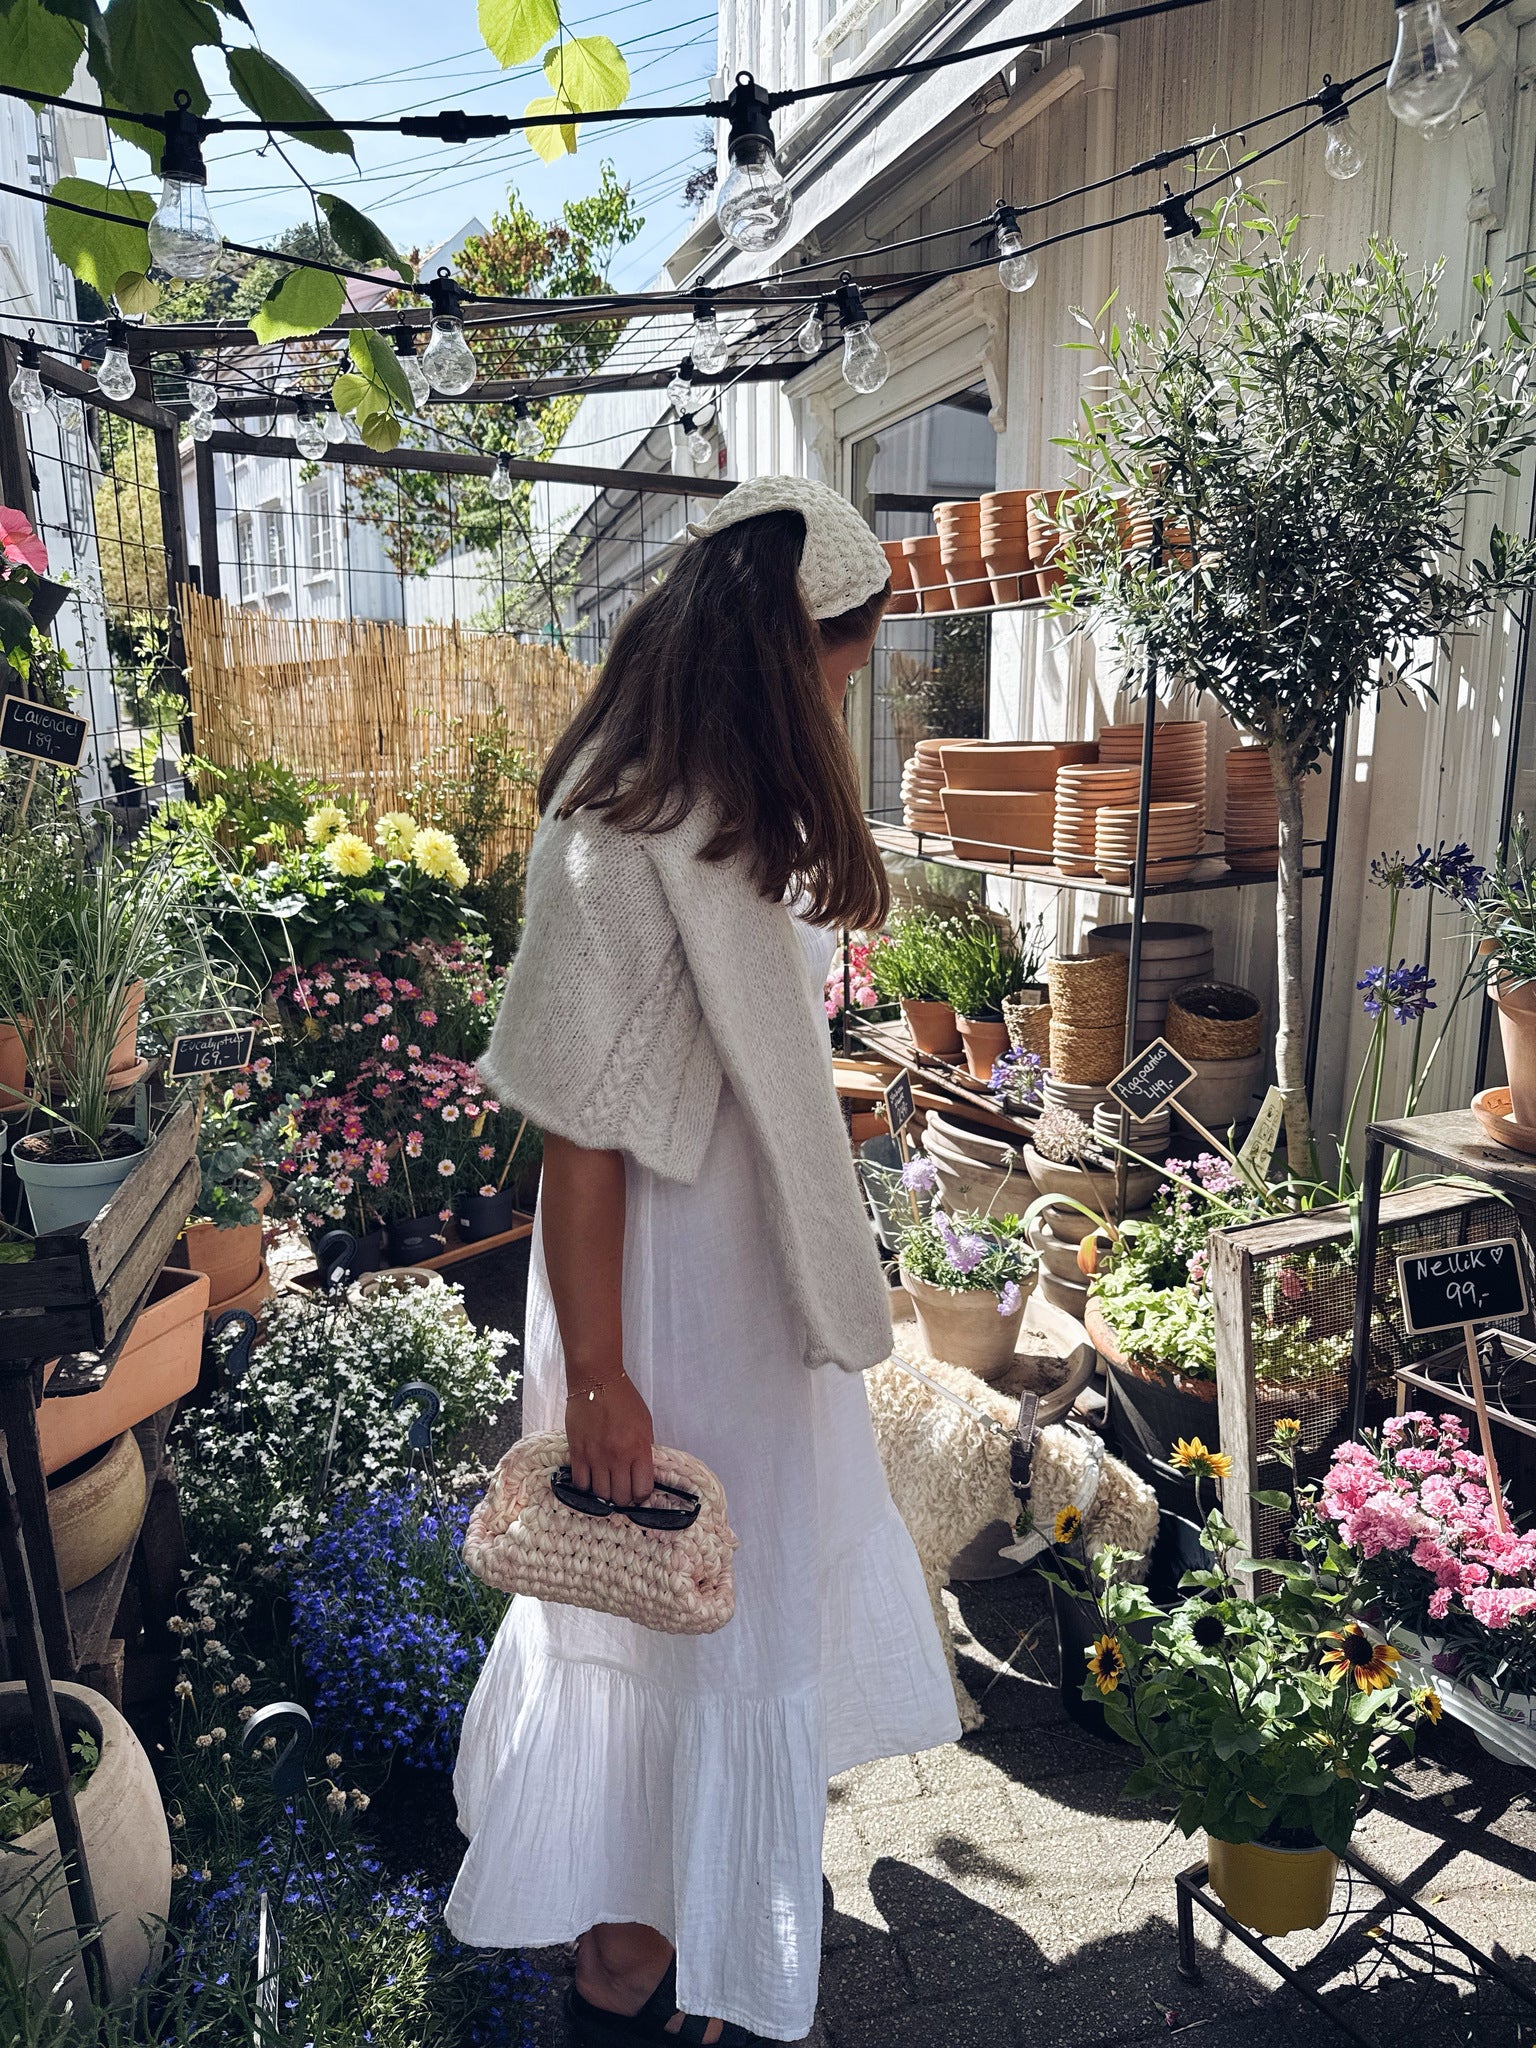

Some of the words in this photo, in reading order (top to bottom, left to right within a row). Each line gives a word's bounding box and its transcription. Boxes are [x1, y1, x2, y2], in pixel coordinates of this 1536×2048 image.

[14, 705, 78, 736] Lavendel
[28, 730, 61, 754] 189,-
[180, 1035, 244, 1052] Eucalyptus
[194, 1051, 230, 1066] 169,-
[1143, 1079, 1174, 1099] 449,-
[1446, 1281, 1490, 1308] 99,-
